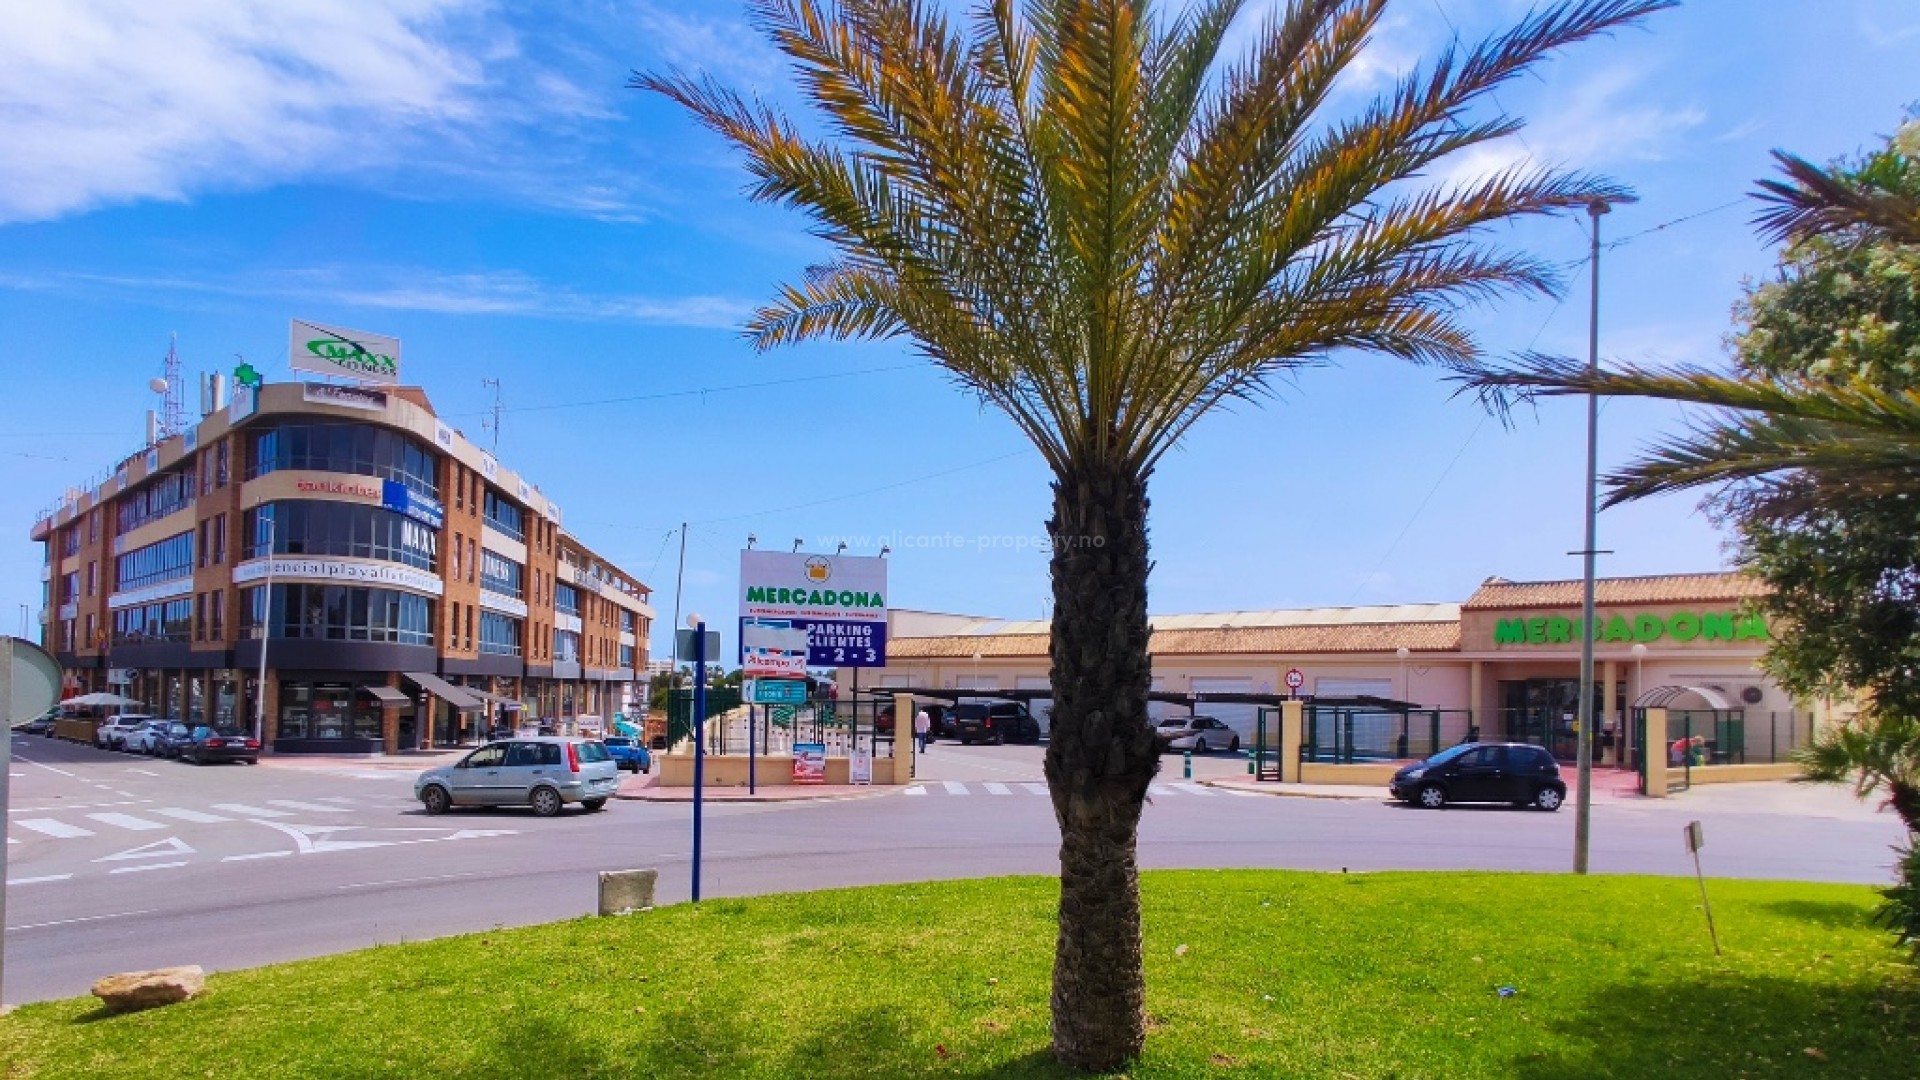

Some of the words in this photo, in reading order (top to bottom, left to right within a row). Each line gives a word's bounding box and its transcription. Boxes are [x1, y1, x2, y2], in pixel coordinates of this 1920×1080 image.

[746, 586, 884, 608] MERCADONA
[806, 623, 873, 636] PARKING
[1494, 611, 1770, 643] MERCADONA
[806, 635, 872, 648] CLIENTES
[833, 647, 845, 662] 2
[865, 648, 877, 663] 3
